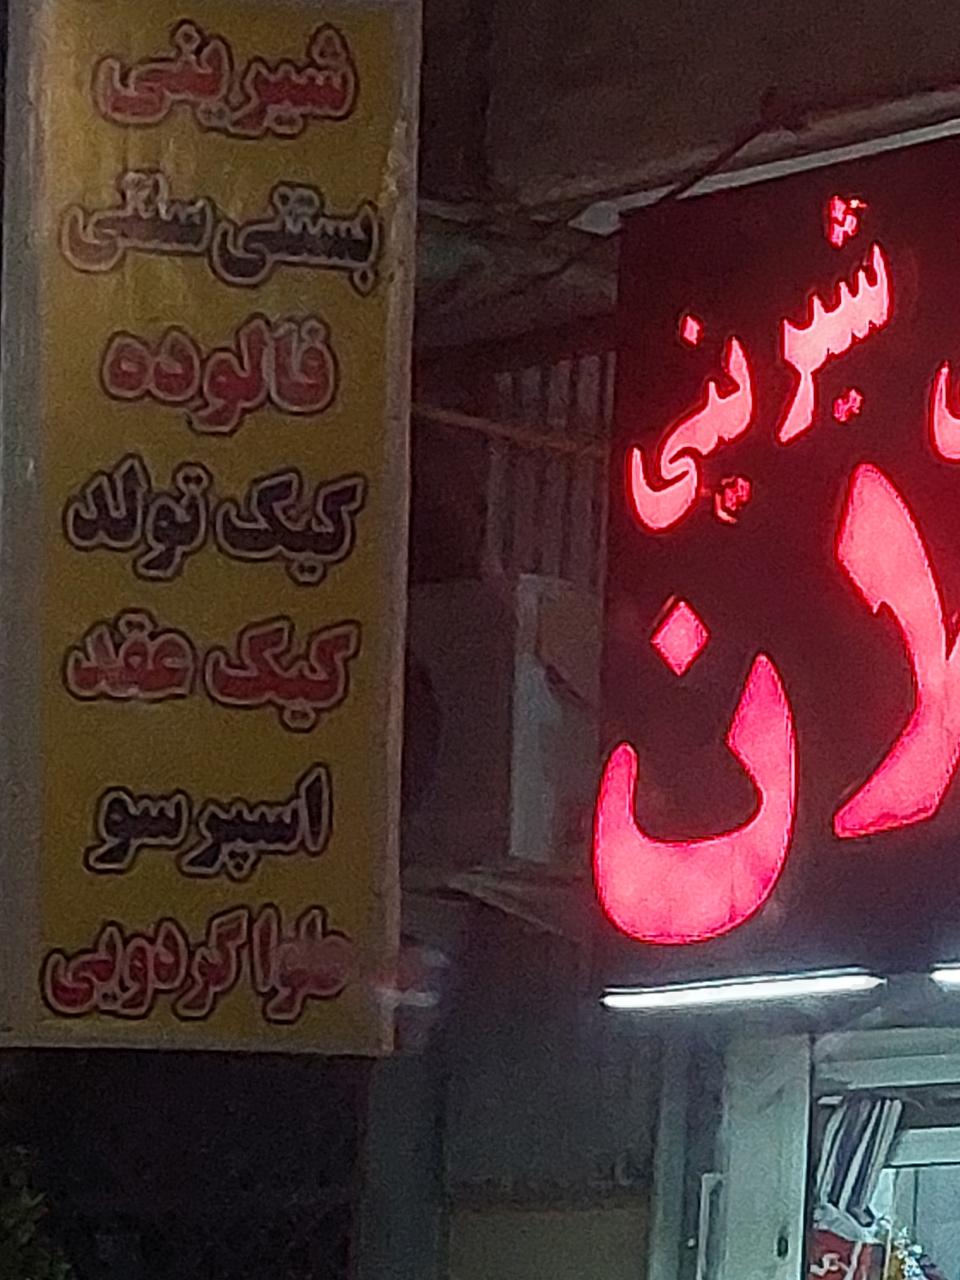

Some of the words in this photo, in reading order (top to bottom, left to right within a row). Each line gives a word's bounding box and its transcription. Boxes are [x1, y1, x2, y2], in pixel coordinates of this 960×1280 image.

[92, 18, 358, 139] شیرینی
[59, 168, 215, 273] سنتی
[210, 181, 381, 297] بستنی
[102, 313, 338, 436] فالوده
[626, 194, 893, 534] شیرینی
[62, 453, 213, 581] تولد
[214, 466, 369, 587] کیک
[204, 614, 363, 734] کیک
